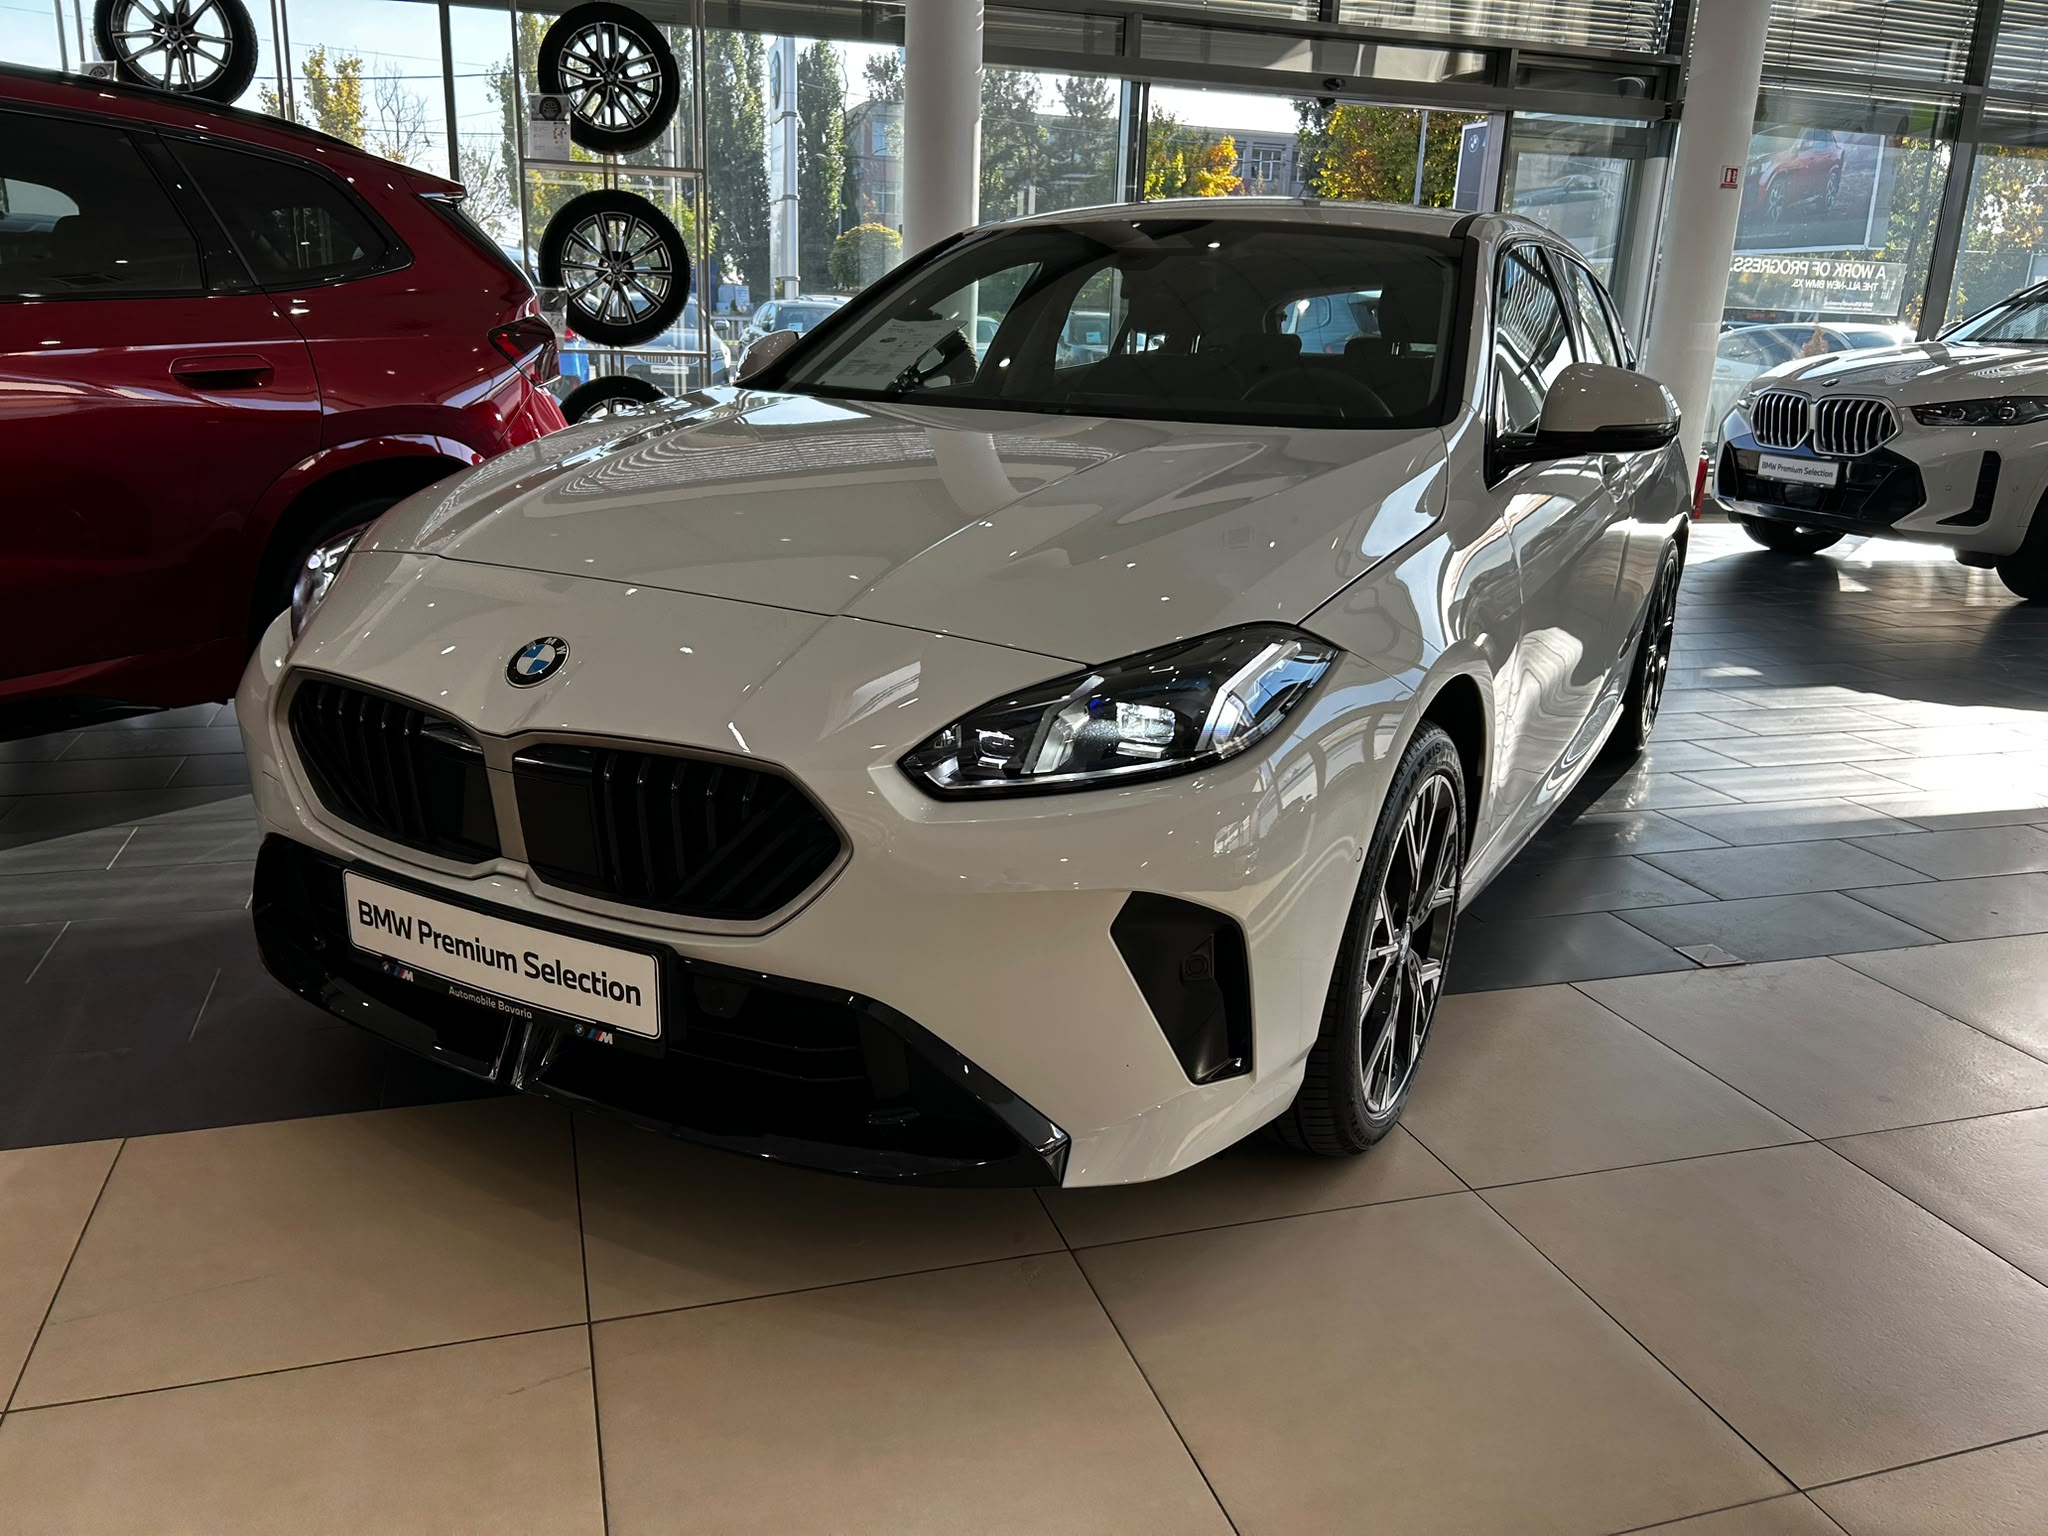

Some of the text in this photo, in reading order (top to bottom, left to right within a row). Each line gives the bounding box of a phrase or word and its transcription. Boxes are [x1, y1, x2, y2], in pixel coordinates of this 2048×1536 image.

[1761, 461, 1833, 478] BMW Premium Selection
[358, 899, 641, 1006] BMW Premium Selection
[448, 985, 533, 1020] Automobile Bavaria
